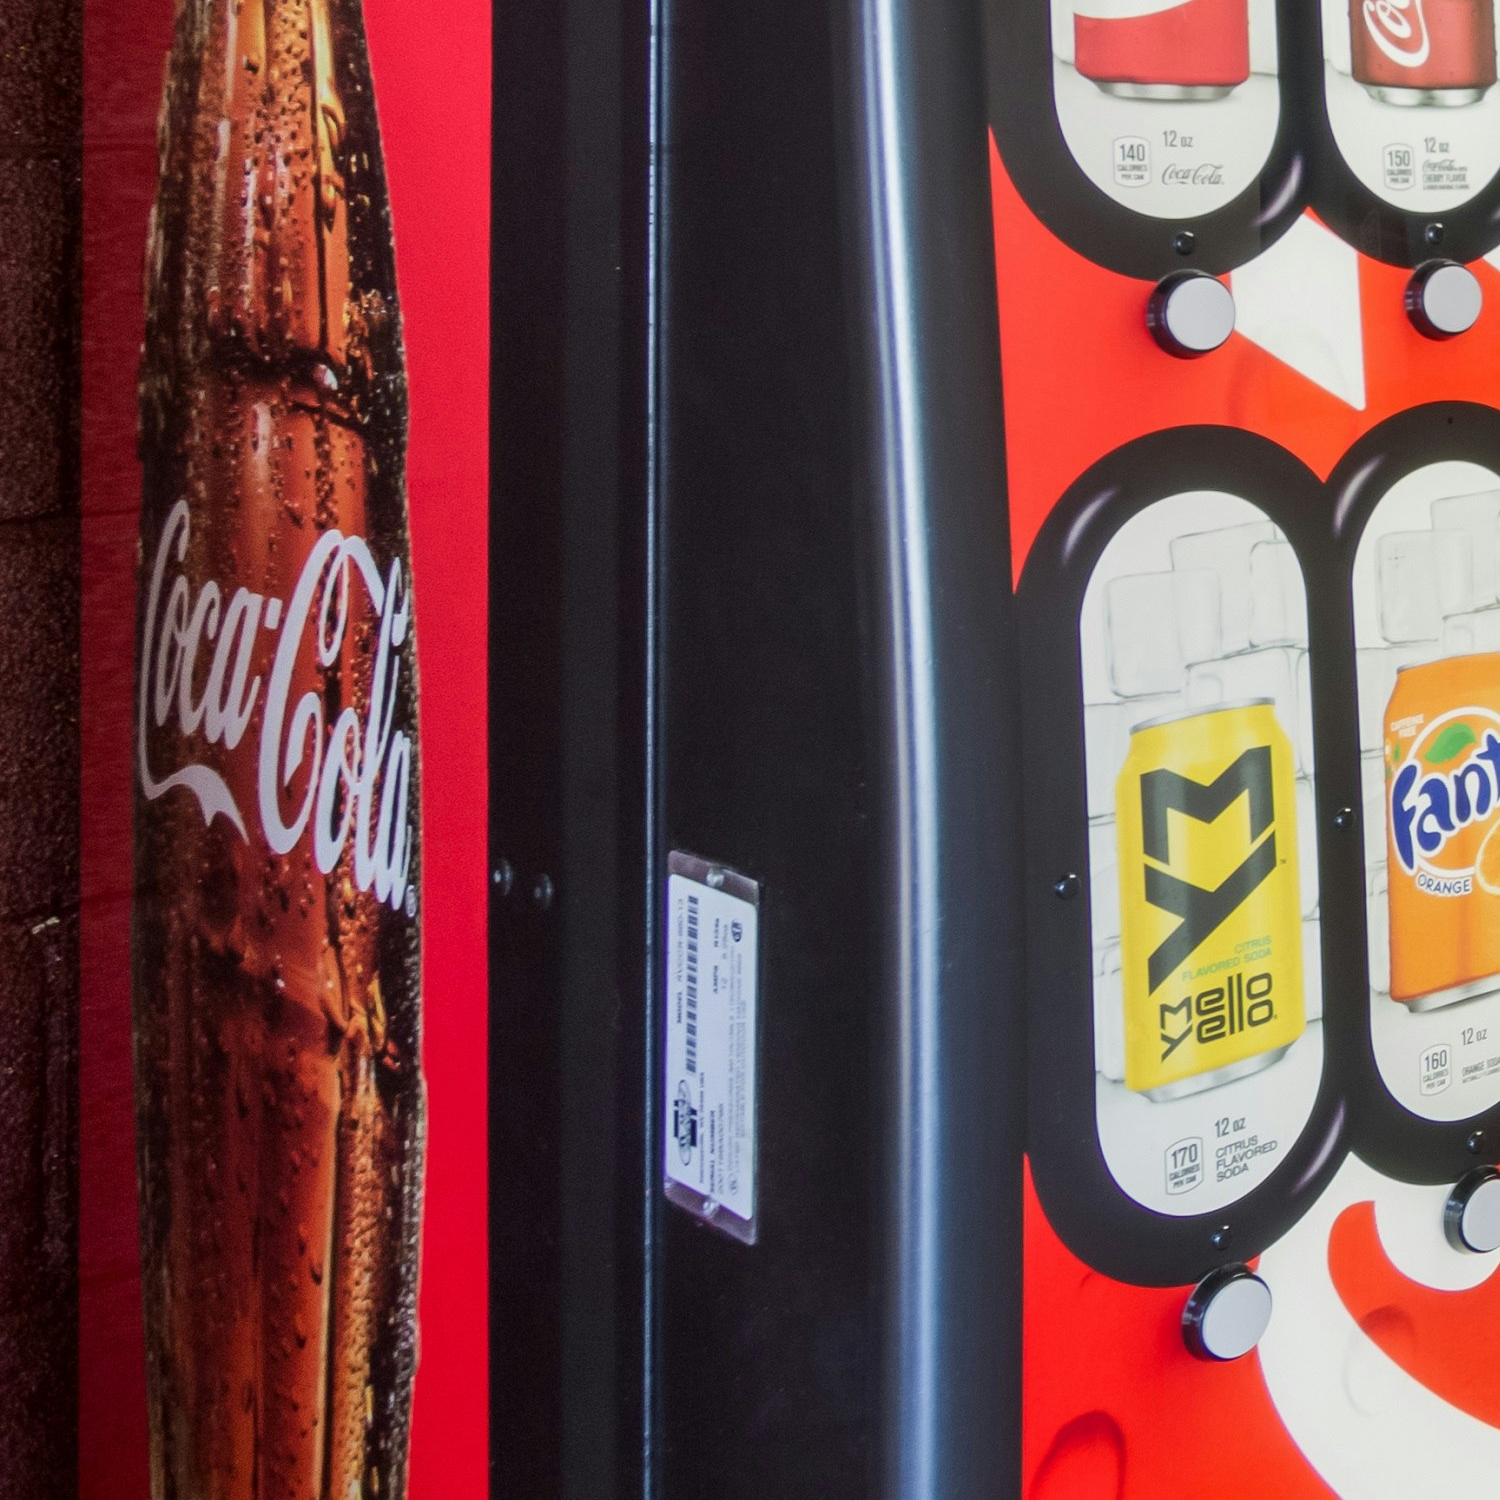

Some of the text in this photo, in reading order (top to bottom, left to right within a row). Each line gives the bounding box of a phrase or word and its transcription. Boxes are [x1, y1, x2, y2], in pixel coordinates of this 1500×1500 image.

[1162, 130, 1177, 148] 12
[1424, 137, 1436, 153] 12
[1120, 144, 1146, 162] 140
[1387, 150, 1411, 167] 150
[1117, 164, 1148, 172] CALORIES
[1162, 163, 1225, 185] Coca-Cola
[138, 500, 412, 912] Coca-Cola
[1399, 726, 1416, 738] FREE
[1418, 874, 1471, 894] ORANGE
[1234, 935, 1272, 954] CITRUS
[1182, 947, 1272, 982] FLAVORED SODA
[1461, 1027, 1474, 1046] 12
[1425, 1049, 1447, 1073] 160
[1214, 1117, 1246, 1138] 12 oz
[1171, 1144, 1198, 1169] 170
[1216, 1135, 1258, 1158] CITRUS
[1216, 1140, 1278, 1171] FLAVORED
[1169, 1163, 1200, 1182] CALORIES
[1216, 1163, 1249, 1183] SODA
